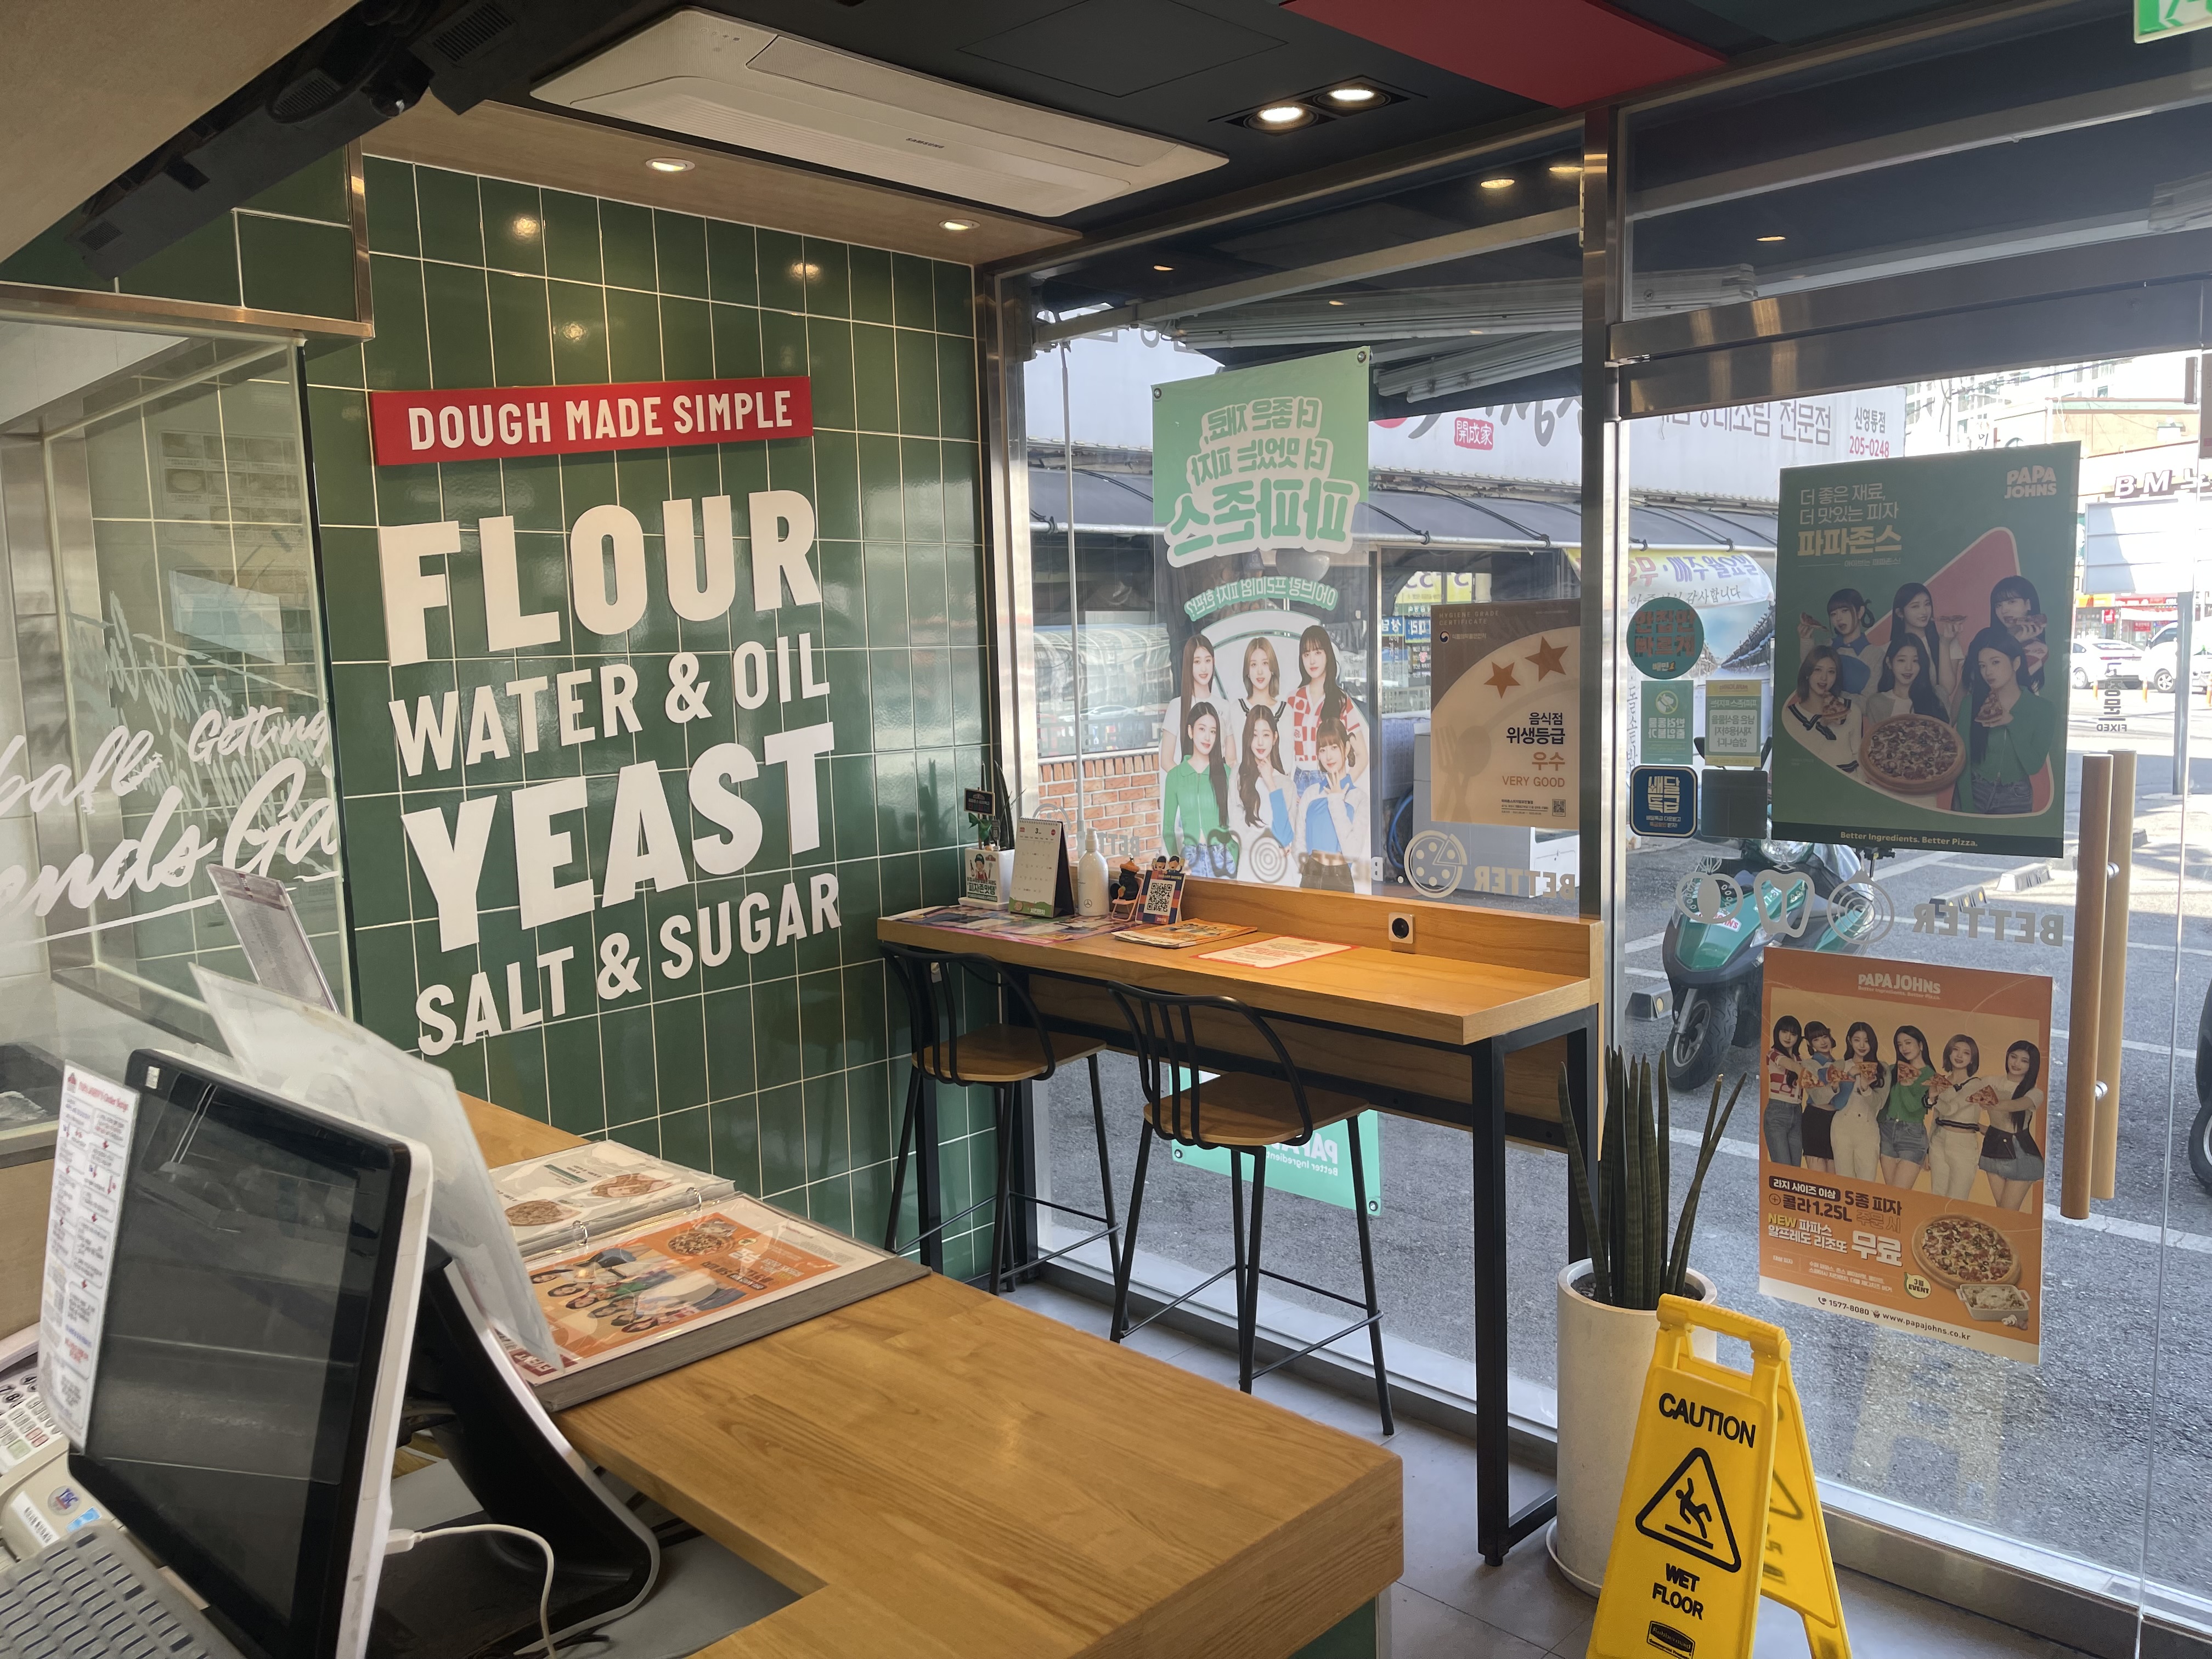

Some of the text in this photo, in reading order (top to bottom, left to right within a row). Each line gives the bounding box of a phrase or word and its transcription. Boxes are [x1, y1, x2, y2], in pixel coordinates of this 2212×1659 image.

[408, 390, 793, 450] DOUGH MADE SIMPLE
[1780, 400, 1831, 445] 전문점
[1854, 407, 1886, 435] 신영통점
[1457, 420, 1493, 445] 開成家
[1849, 436, 1889, 459] 205-0248
[2006, 465, 2057, 485] PAPA
[1801, 483, 1886, 506] 더 좋은 재료,
[2004, 483, 2057, 499] JOHNS
[1799, 501, 1899, 525] 더 맛있는 피자
[1797, 525, 1902, 556] 파파존스
[379, 490, 822, 667] FLOUR
[1685, 585, 1741, 603] 감사합니다
[1634, 635, 1695, 657] 빠르게
[1652, 662, 1675, 672] 배민1
[388, 632, 830, 777] WATER & OIL
[1529, 712, 1563, 725] 음식점
[1506, 727, 1565, 744] 위생등급
[1532, 752, 1565, 771] 우수
[1502, 775, 1565, 787] VERY GOOD
[400, 722, 834, 953] YEAST
[1841, 831, 1978, 847] Better Ingredients. Better Pizza.
[416, 946, 575, 1057] SALT
[597, 932, 642, 1000] &
[661, 873, 842, 979] SUGAR
[1858, 973, 1941, 994] PAPA JOHNS
[1773, 1178, 1836, 1200] 라지 사이즈 이상
[1845, 1190, 1902, 1216] 5종 피자
[1768, 1213, 1832, 1237] NEW 파파스
[1857, 1210, 1884, 1229] 주문
[1887, 1216, 1901, 1233] 시
[1768, 1224, 1848, 1254] 알프레도 리조또
[1852, 1231, 1903, 1267] 무료
[1909, 1284, 1929, 1294] EVENT
[1829, 1299, 1971, 1340] 1577-8080 www.papajohns.co.kr
[1659, 1392, 1756, 1448] CAUTION
[1666, 1563, 1700, 1592] WET
[1652, 1582, 1703, 1620] FLOOR
[1653, 1627, 1691, 1650] Rubbermaid
